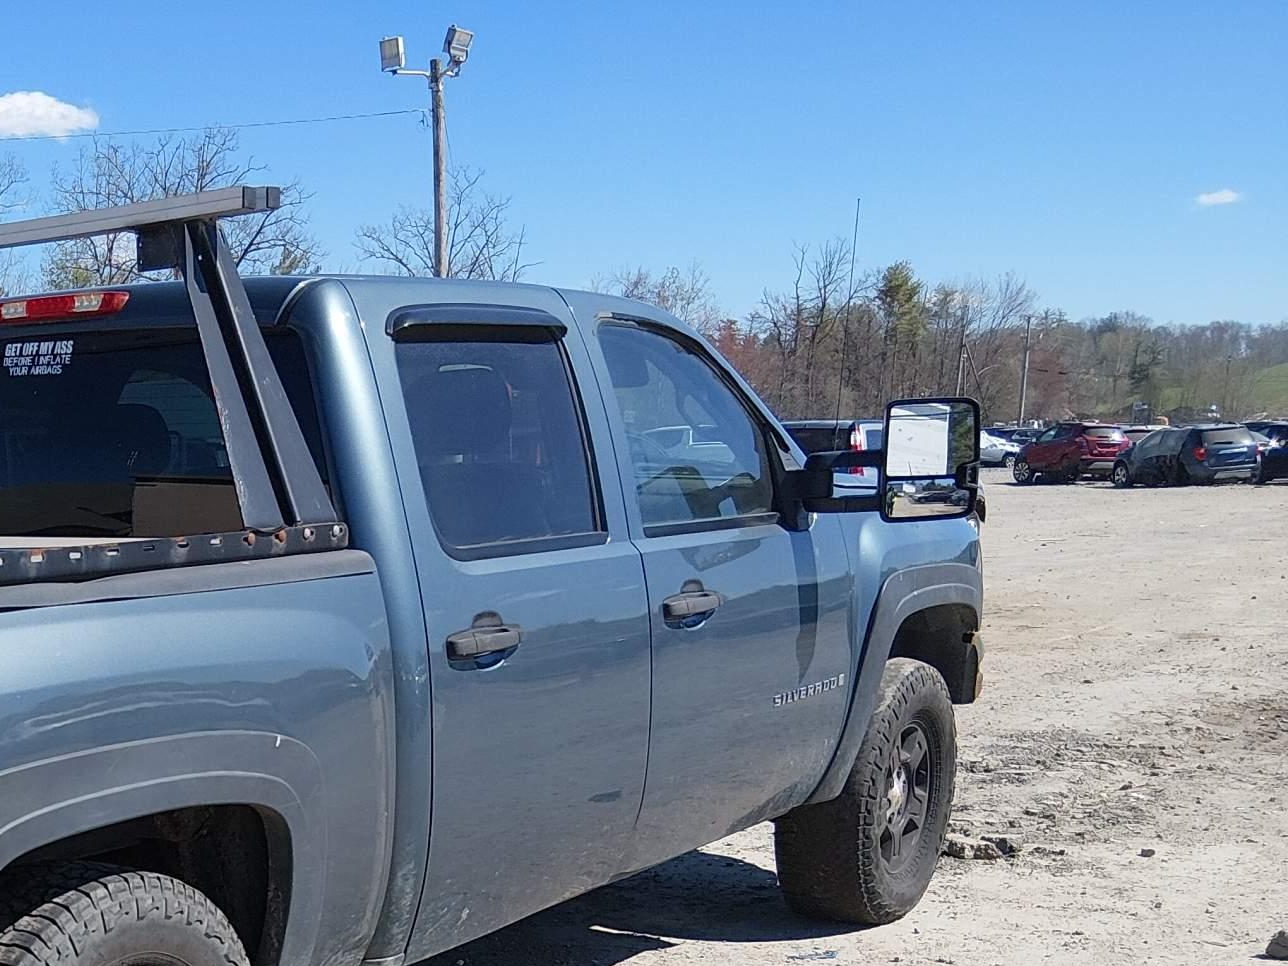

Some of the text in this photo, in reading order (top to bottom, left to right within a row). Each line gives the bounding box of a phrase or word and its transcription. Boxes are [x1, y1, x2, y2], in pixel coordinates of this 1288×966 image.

[5, 340, 73, 356] GET OFF MY ASS
[3, 355, 71, 366] BEFORE I INFLATE
[9, 365, 62, 376] YOUR AIRBAGS
[773, 677, 837, 707] SILVERADO
